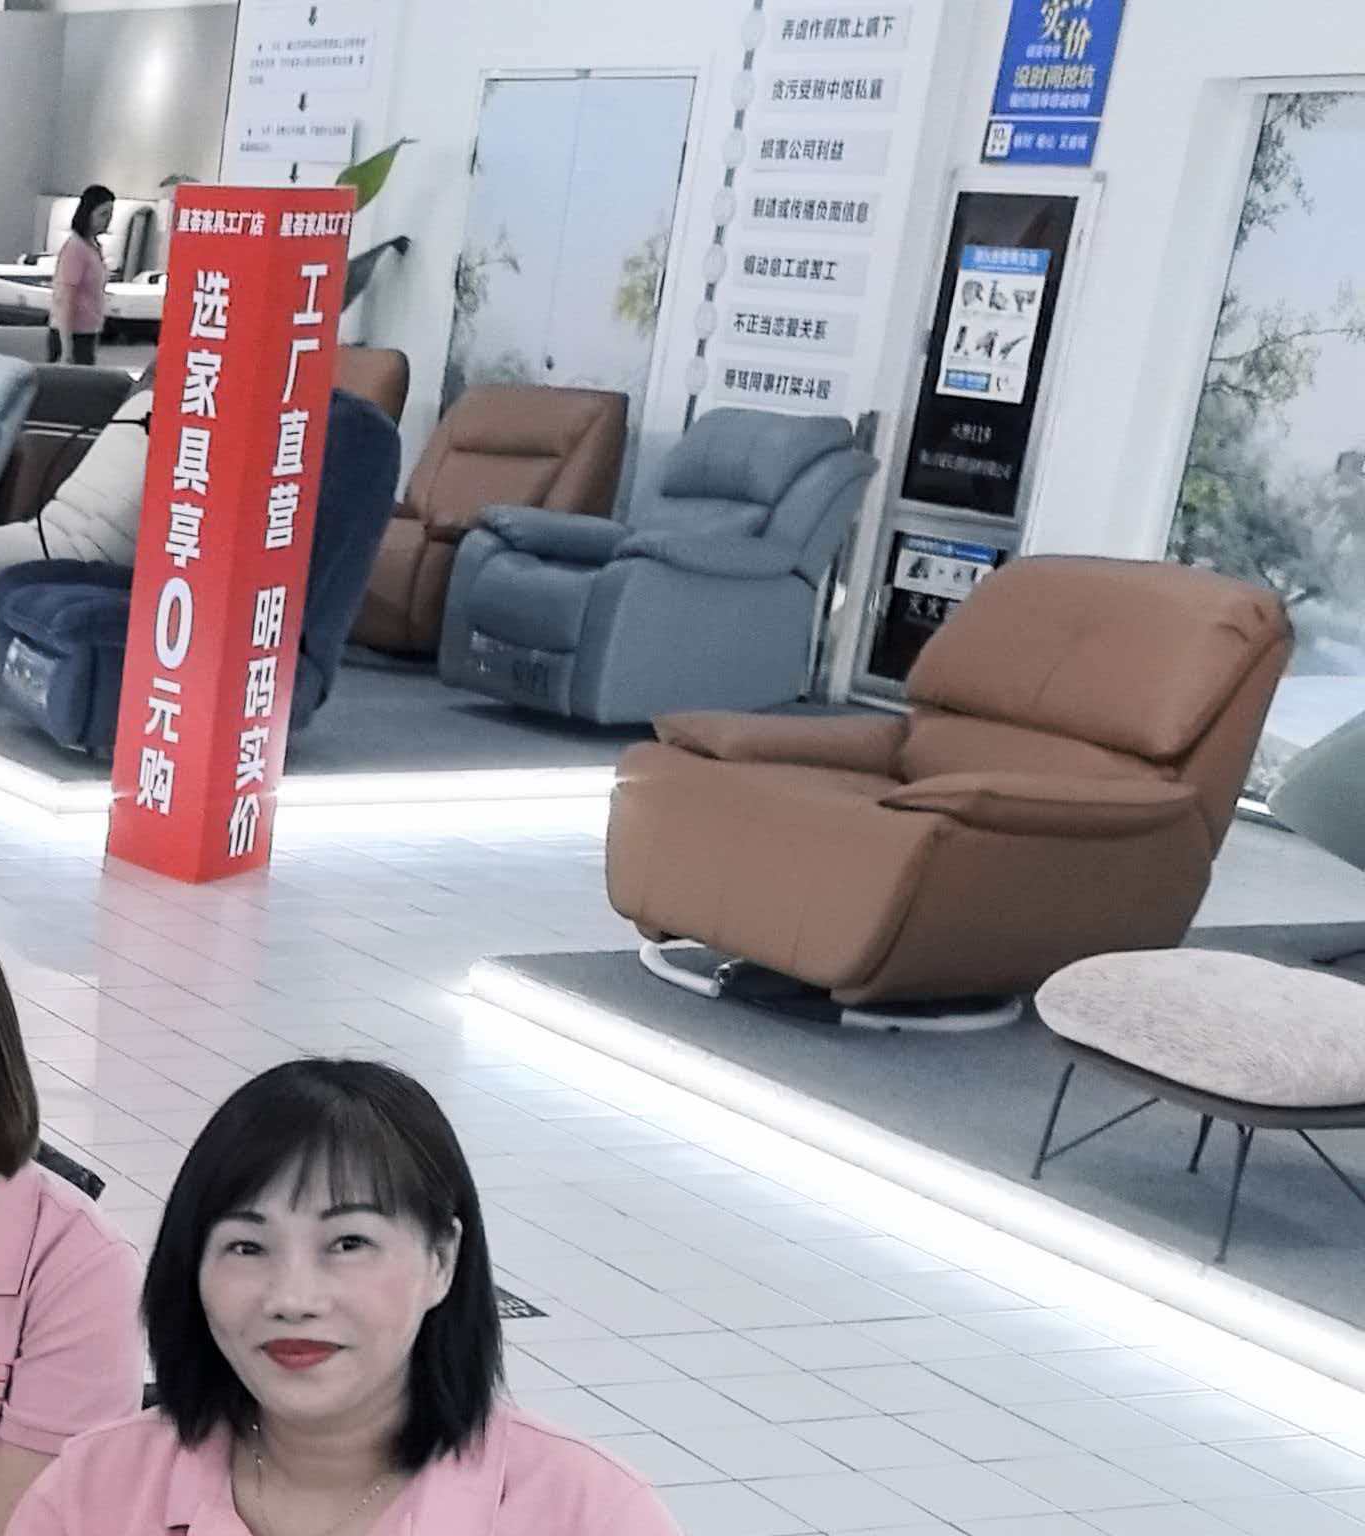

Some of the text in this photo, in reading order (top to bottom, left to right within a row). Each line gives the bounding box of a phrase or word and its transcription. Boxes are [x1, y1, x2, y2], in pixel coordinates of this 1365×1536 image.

[760, 138, 845, 161] 损害公司利益
[177, 208, 266, 237] 星荟家具工厂店
[733, 312, 829, 341] 不正当恋爱关系
[136, 269, 231, 817] 选家具享0元购
[228, 263, 328, 859] 工厂直营 明码实价
